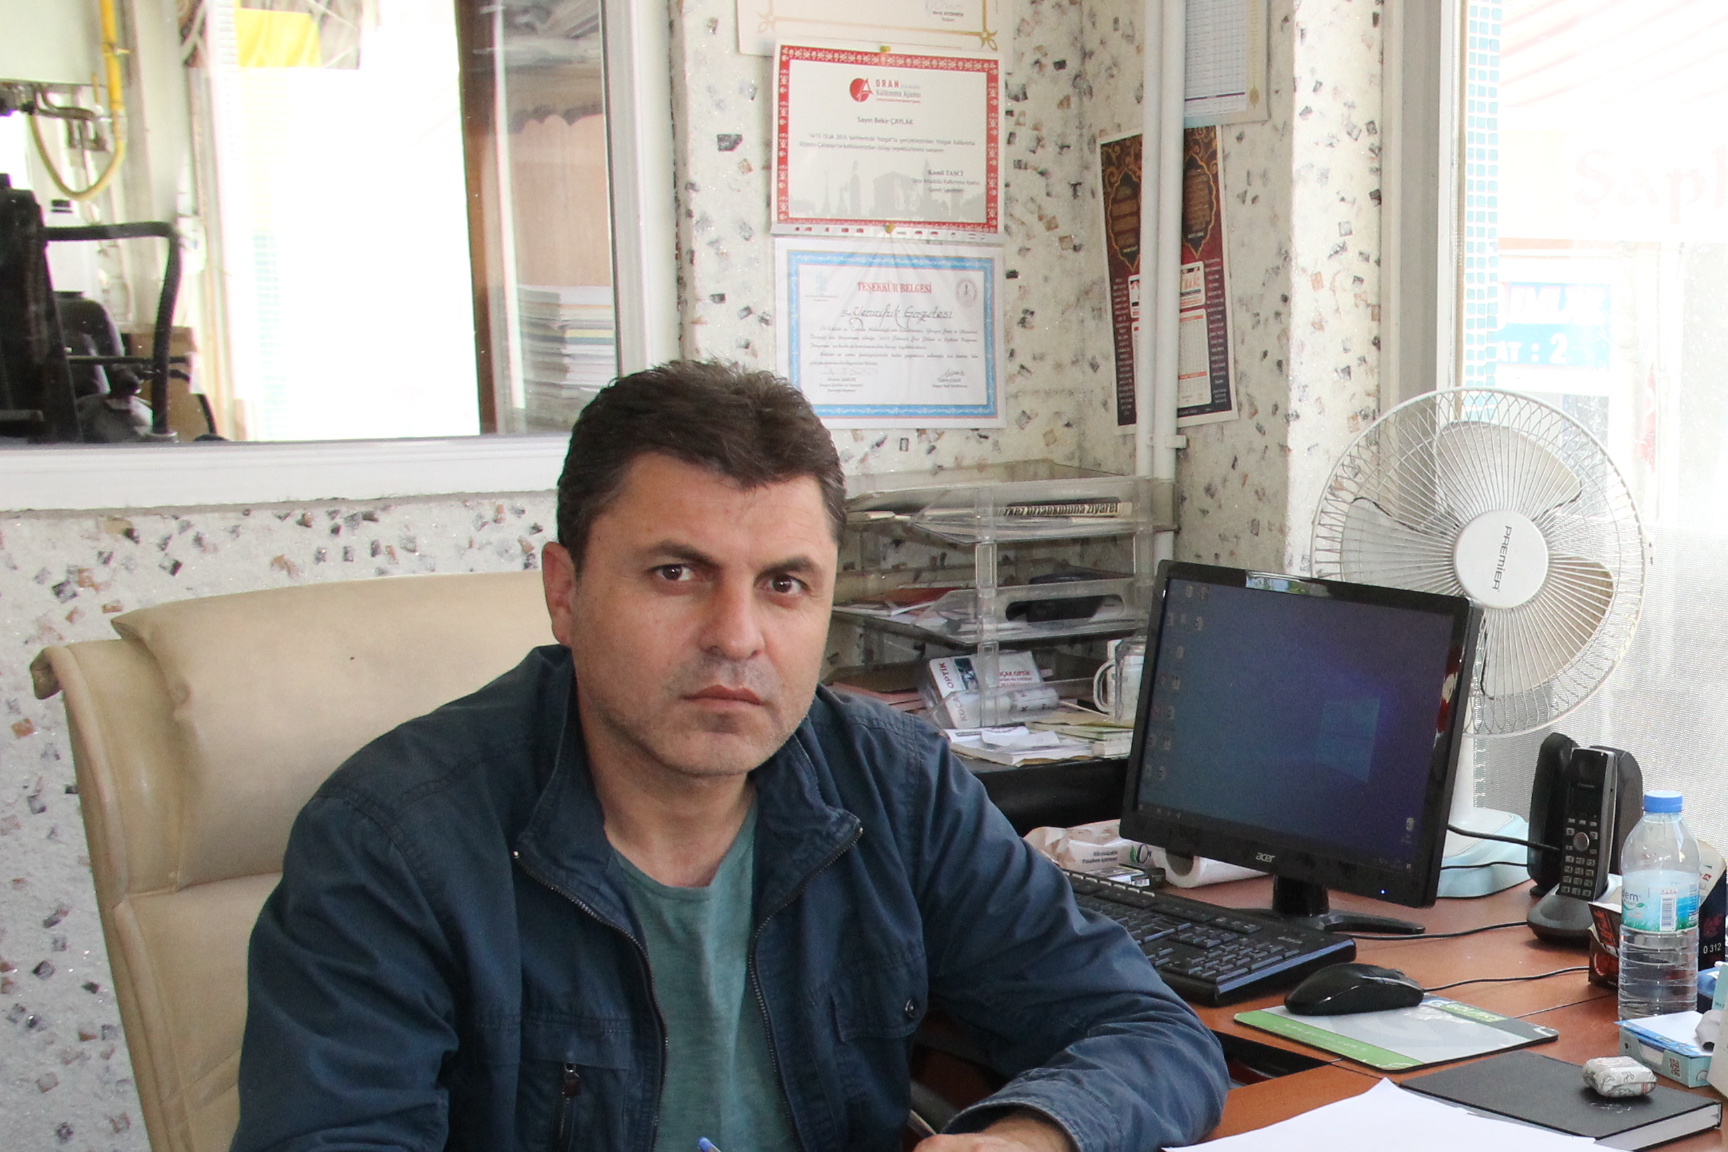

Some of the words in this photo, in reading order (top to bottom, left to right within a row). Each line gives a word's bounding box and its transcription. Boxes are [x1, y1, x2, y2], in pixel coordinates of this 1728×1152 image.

[857, 281, 899, 295] TEŞEKKÜR
[900, 282, 932, 294] BELGESİ
[1255, 852, 1276, 863] acer
[1709, 942, 1722, 953] 312
